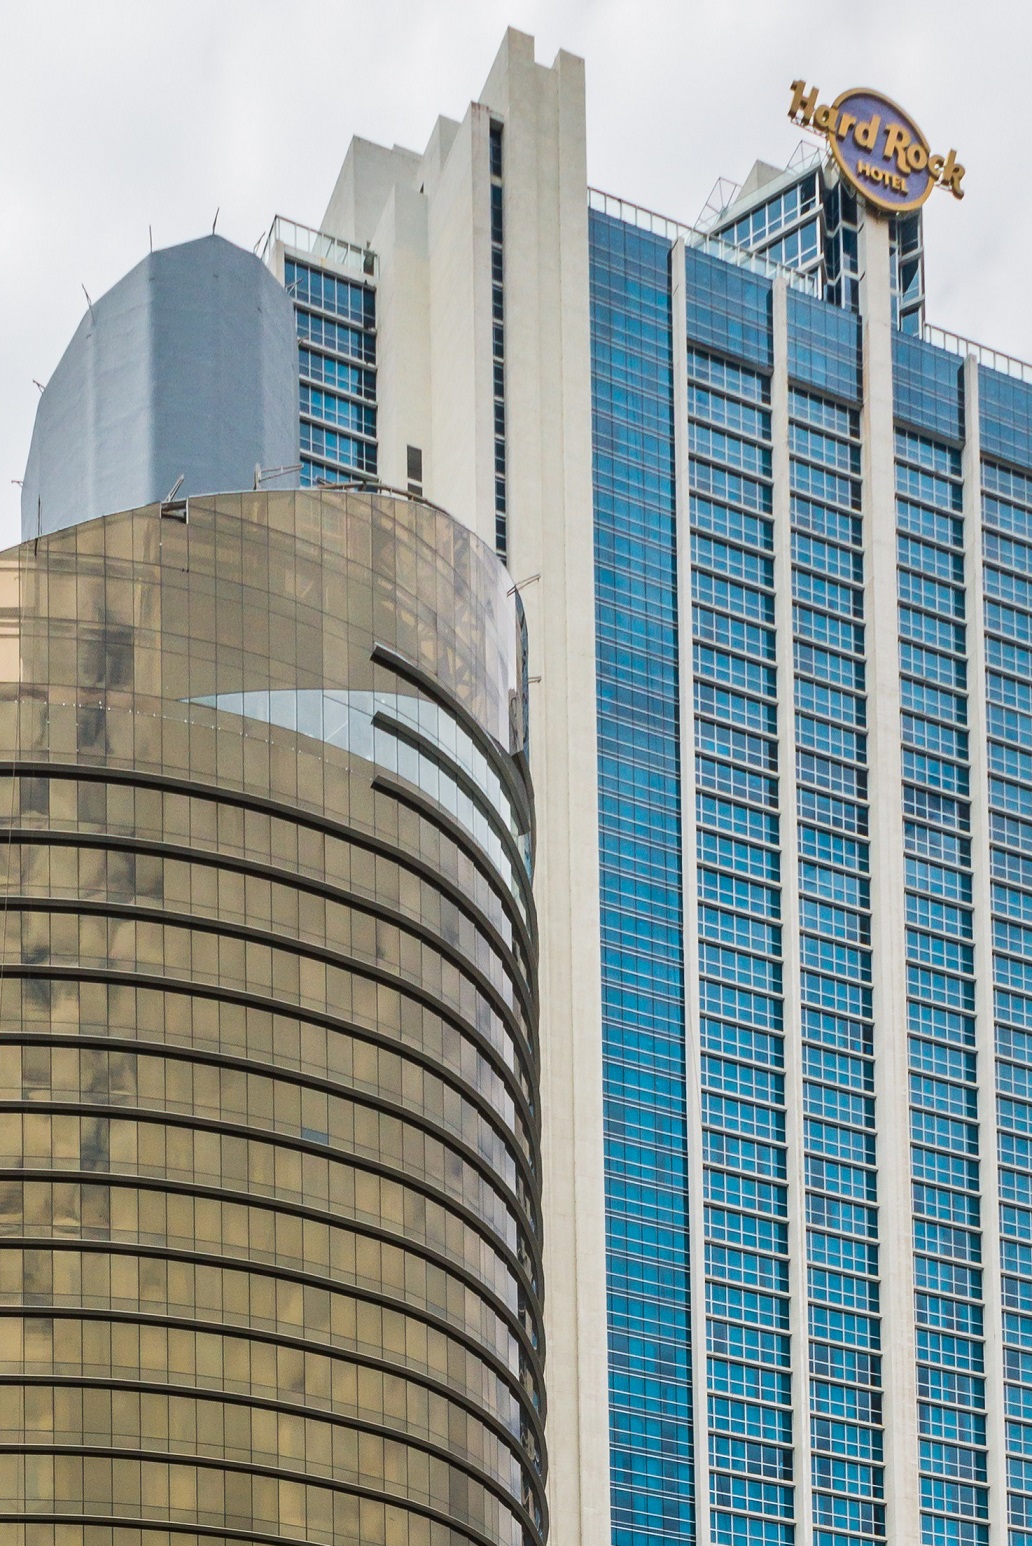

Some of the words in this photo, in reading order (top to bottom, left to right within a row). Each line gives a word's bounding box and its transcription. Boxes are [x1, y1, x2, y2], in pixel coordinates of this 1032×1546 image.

[787, 79, 881, 153] Hard
[883, 122, 966, 200] Rock
[856, 159, 909, 196] HOTEL
